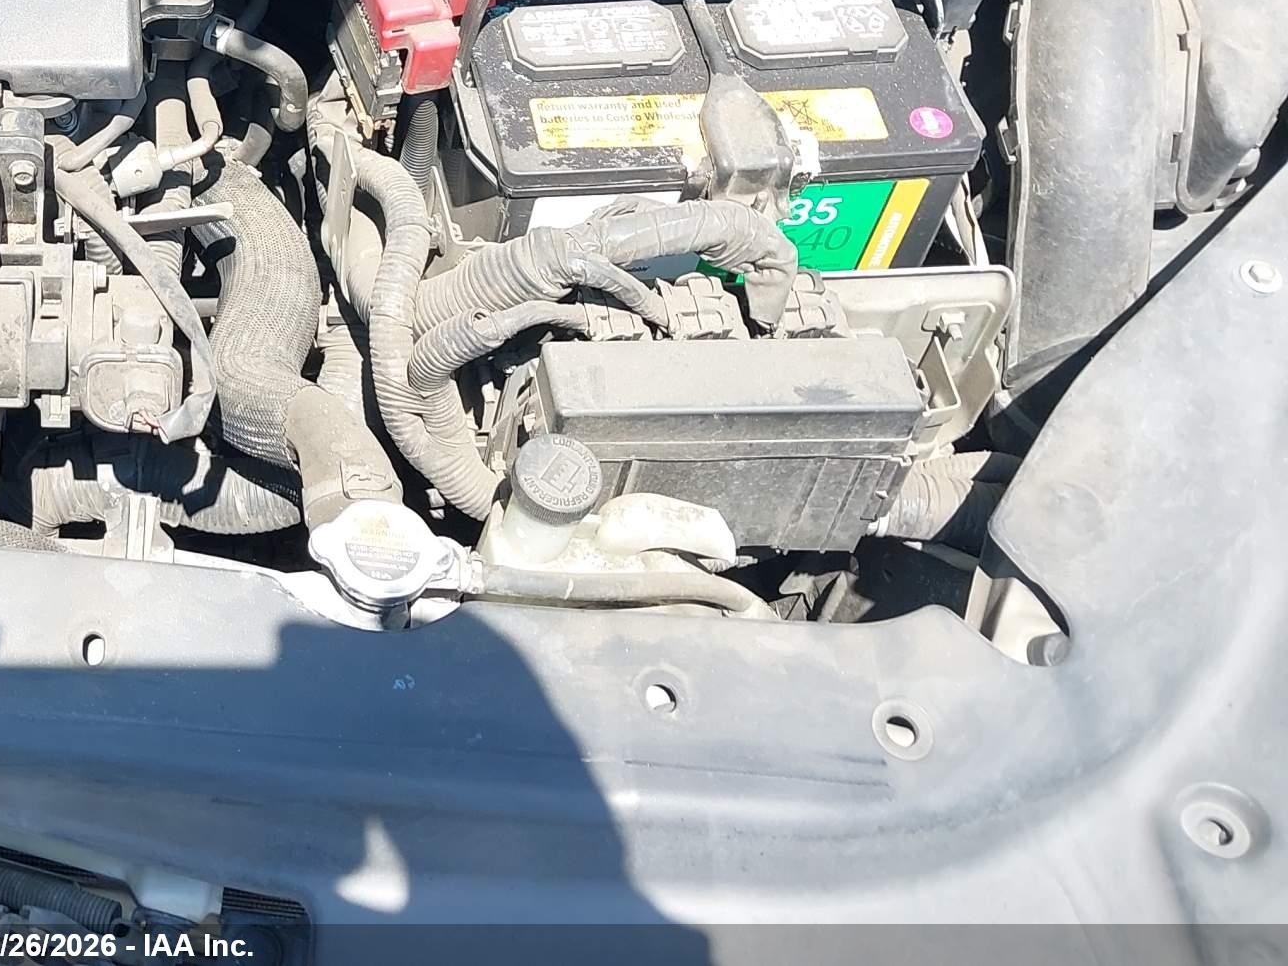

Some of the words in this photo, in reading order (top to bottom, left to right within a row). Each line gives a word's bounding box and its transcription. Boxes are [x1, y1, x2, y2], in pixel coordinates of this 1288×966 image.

[537, 102, 574, 112] Return
[577, 101, 628, 113] warranty
[631, 99, 652, 109] and
[655, 99, 681, 109] used
[539, 114, 590, 124] batteries
[593, 114, 603, 122] to
[606, 113, 642, 123] Costco
